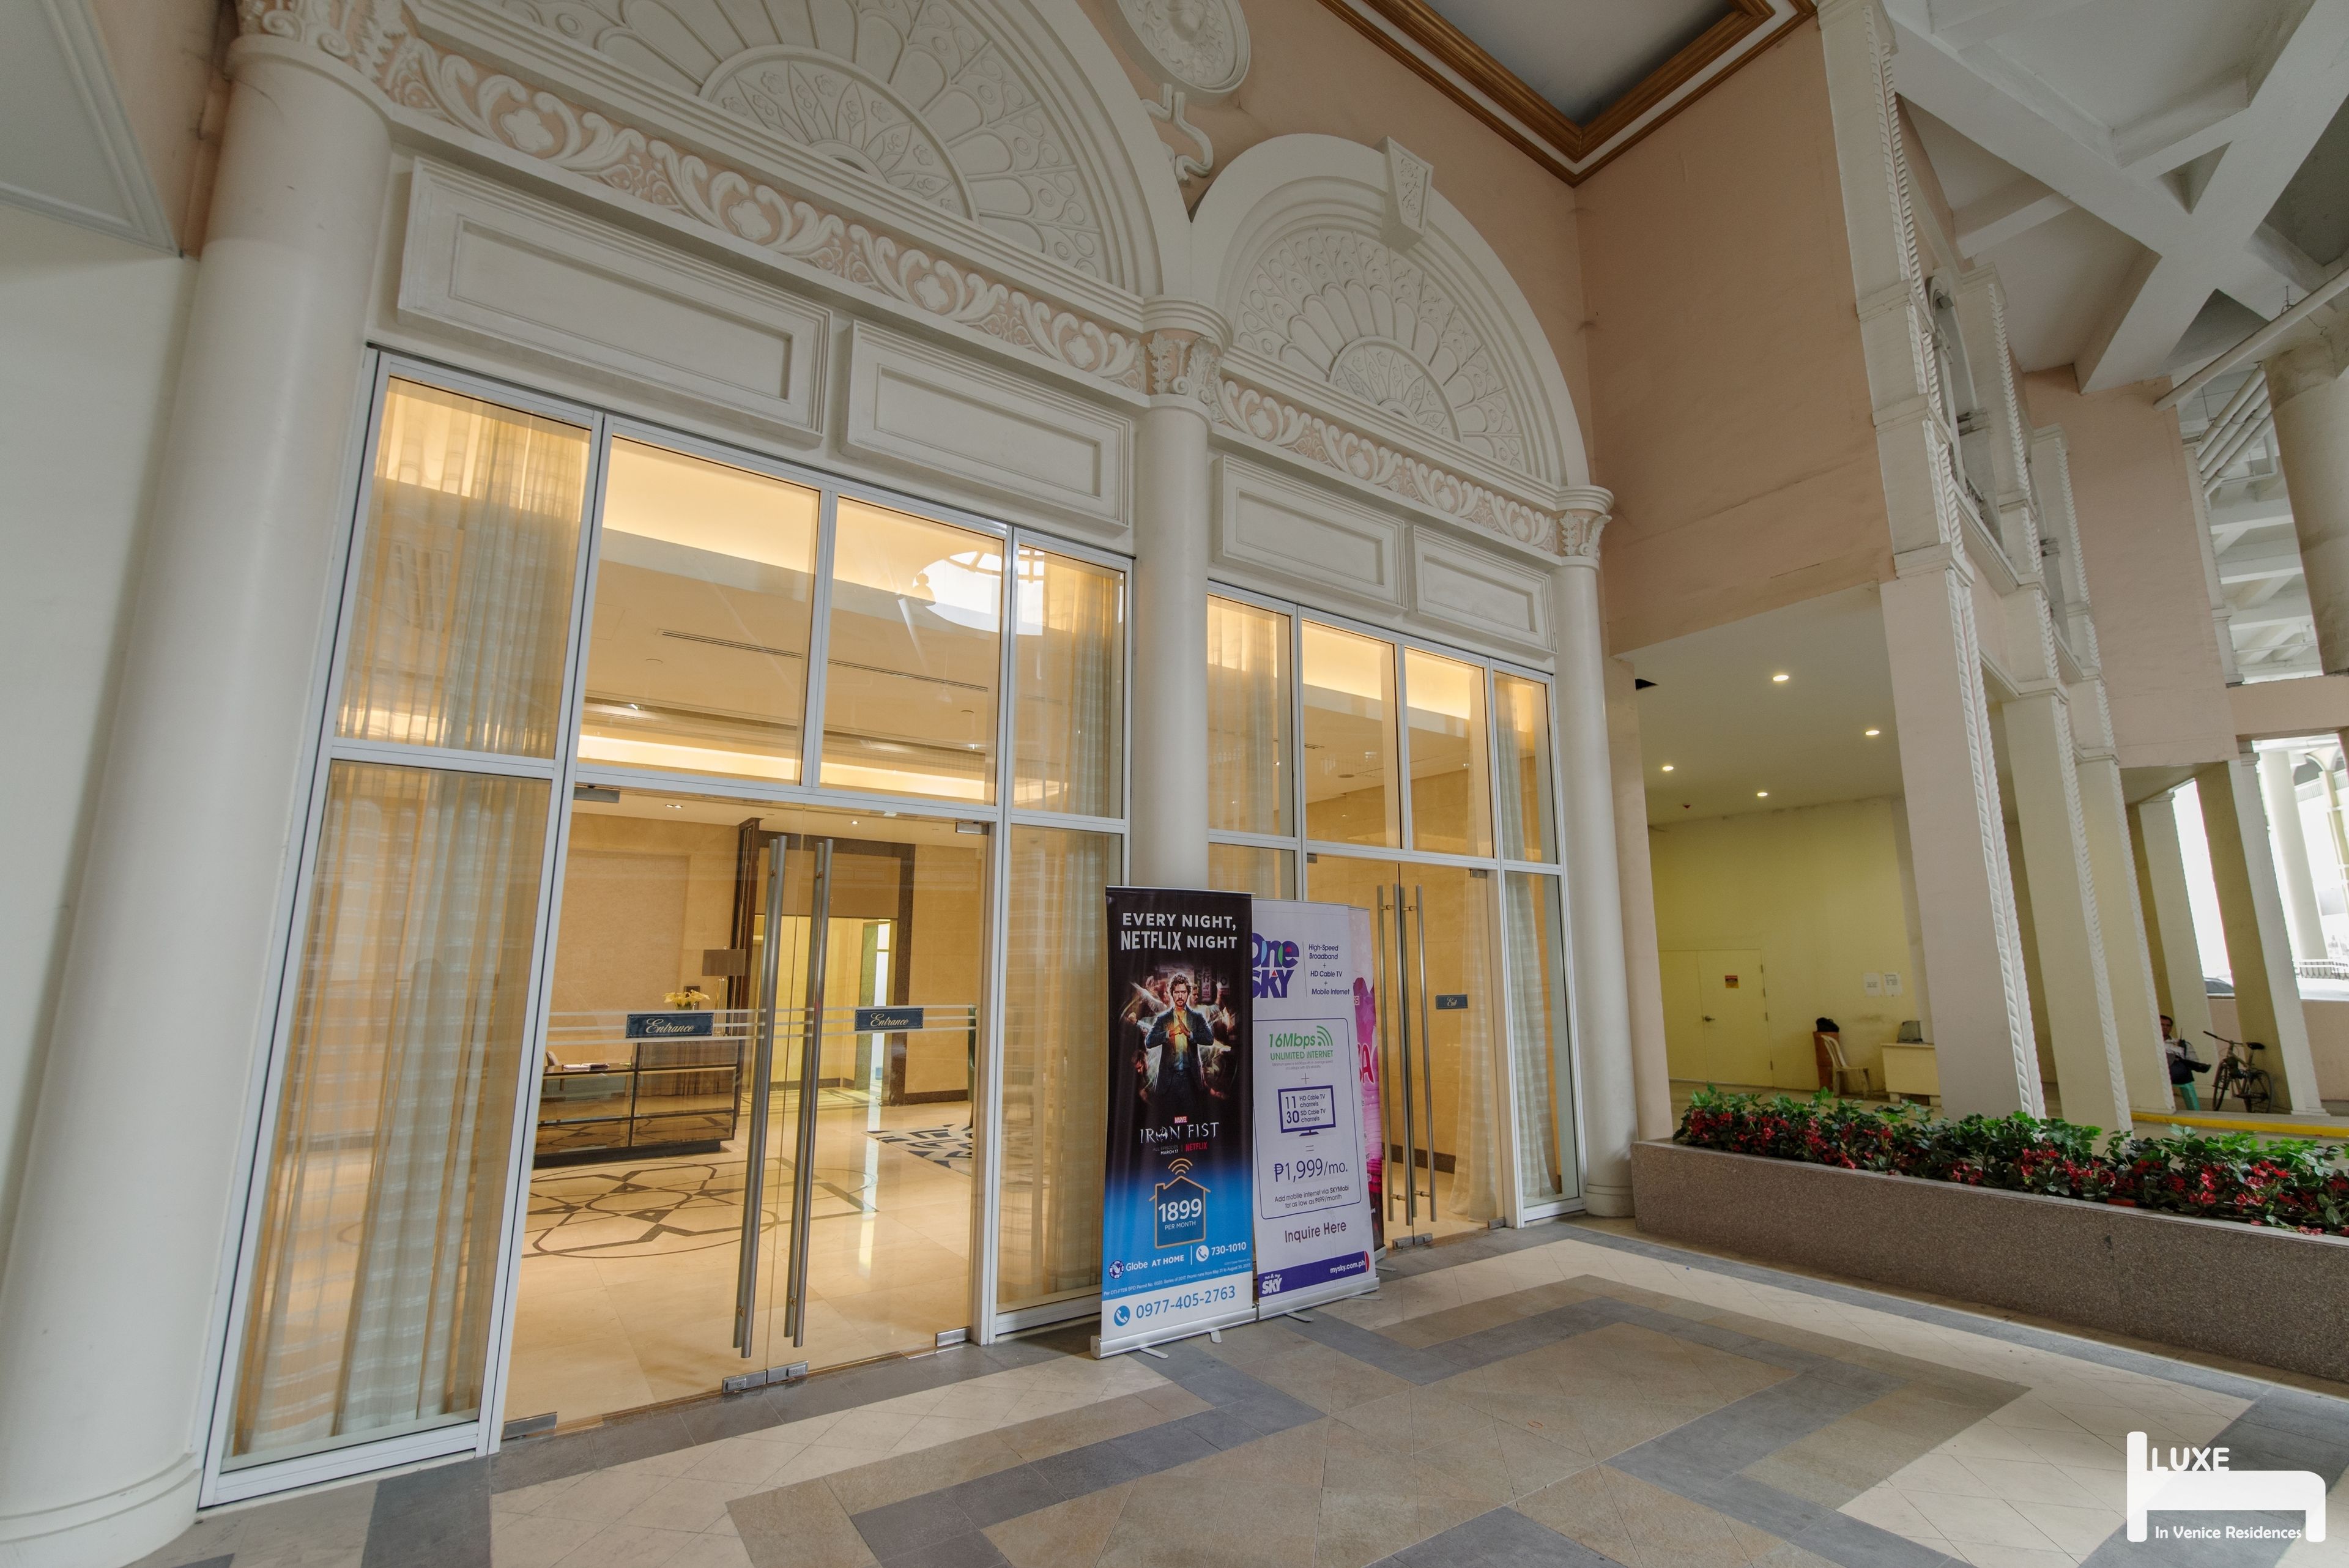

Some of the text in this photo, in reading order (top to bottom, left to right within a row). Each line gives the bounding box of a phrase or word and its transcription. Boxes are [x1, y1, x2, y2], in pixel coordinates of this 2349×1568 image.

[1123, 913, 1236, 931] EVERY NIGHT,
[1121, 931, 1238, 951] NETFLIX NIGHT
[645, 1018, 695, 1034] Entrance
[870, 1013, 909, 1027] Entrance
[1269, 1033, 1316, 1049] 16Mbps
[1270, 1050, 1333, 1060] UNLIMITED INTERNET
[1285, 1096, 1296, 1109] 11
[1286, 1110, 1299, 1124] 30
[1140, 1122, 1219, 1143] IRON FIST
[1186, 1142, 1208, 1152] NETFLIX
[1330, 1185, 1349, 1194] SKYMobi
[1158, 1198, 1202, 1222] 1899
[1285, 1221, 1346, 1243] Inquire Here
[1211, 1242, 1247, 1256] 730-1010
[1126, 1261, 1148, 1272] Globe
[1163, 1255, 1184, 1265] HOME
[1330, 1260, 1365, 1274] mysky.com.ph
[1262, 1277, 1282, 1295] SKY
[1136, 1285, 1236, 1319] 0977-405-2763
